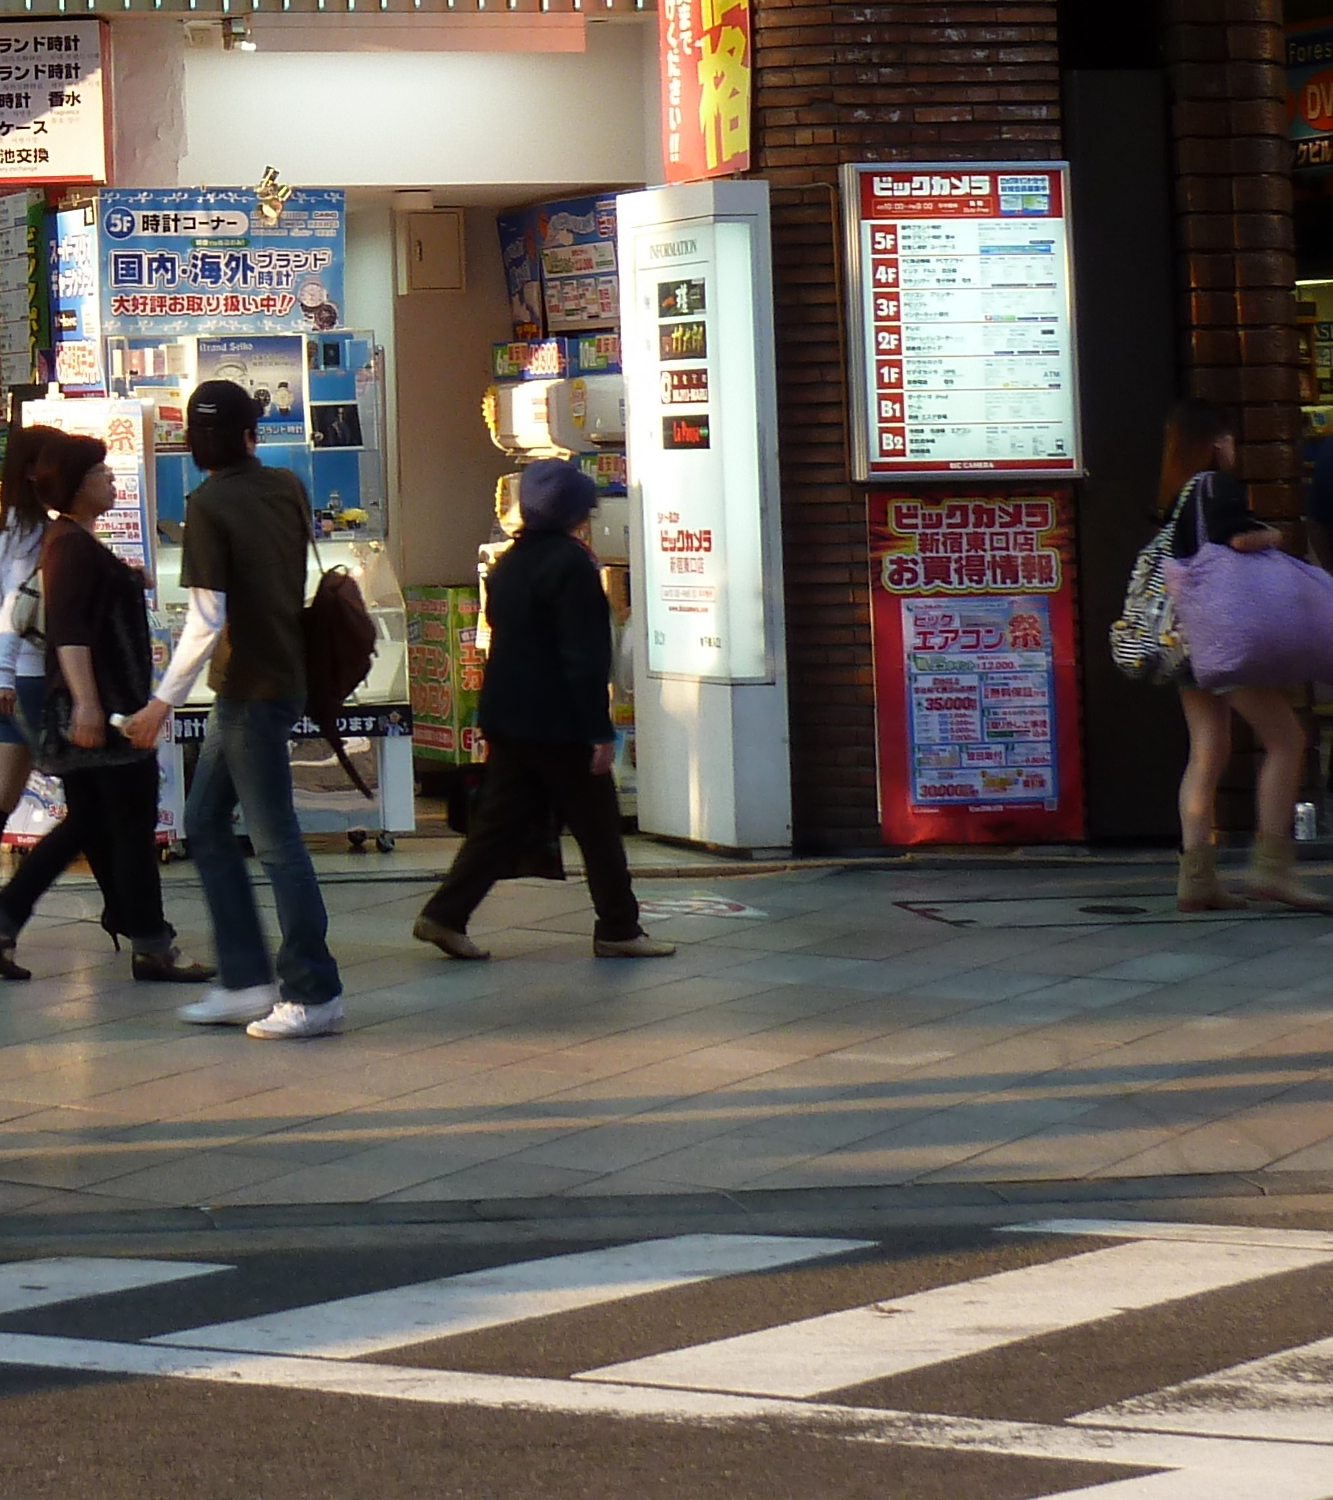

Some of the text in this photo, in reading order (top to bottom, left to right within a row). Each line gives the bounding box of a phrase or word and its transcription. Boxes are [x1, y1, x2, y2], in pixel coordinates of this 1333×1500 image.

[48, 90, 82, 108] 香水
[872, 176, 991, 196] ビックカメラ
[108, 213, 132, 233] 5F
[141, 213, 238, 234] 時計コーナー
[648, 238, 698, 259] INFORMATION
[874, 232, 895, 250] 5F
[111, 250, 256, 289] 国内・海外
[256, 251, 328, 271] ブランド
[257, 270, 293, 286] 時計
[875, 266, 897, 283] 4F
[111, 293, 296, 317] 大好評お取り扱い中!!
[877, 299, 898, 316] 3F
[877, 332, 899, 350] 2F
[880, 366, 900, 383] 1F
[880, 400, 901, 417] B1
[882, 433, 904, 451] B2
[894, 503, 1052, 530] ビックカメラ
[660, 529, 713, 555] ビックカメラ
[918, 532, 1037, 553] 新宿東口店
[887, 555, 1054, 587] お買得情報
[913, 614, 954, 628] ビック
[913, 613, 1042, 652] エアコン 祭
